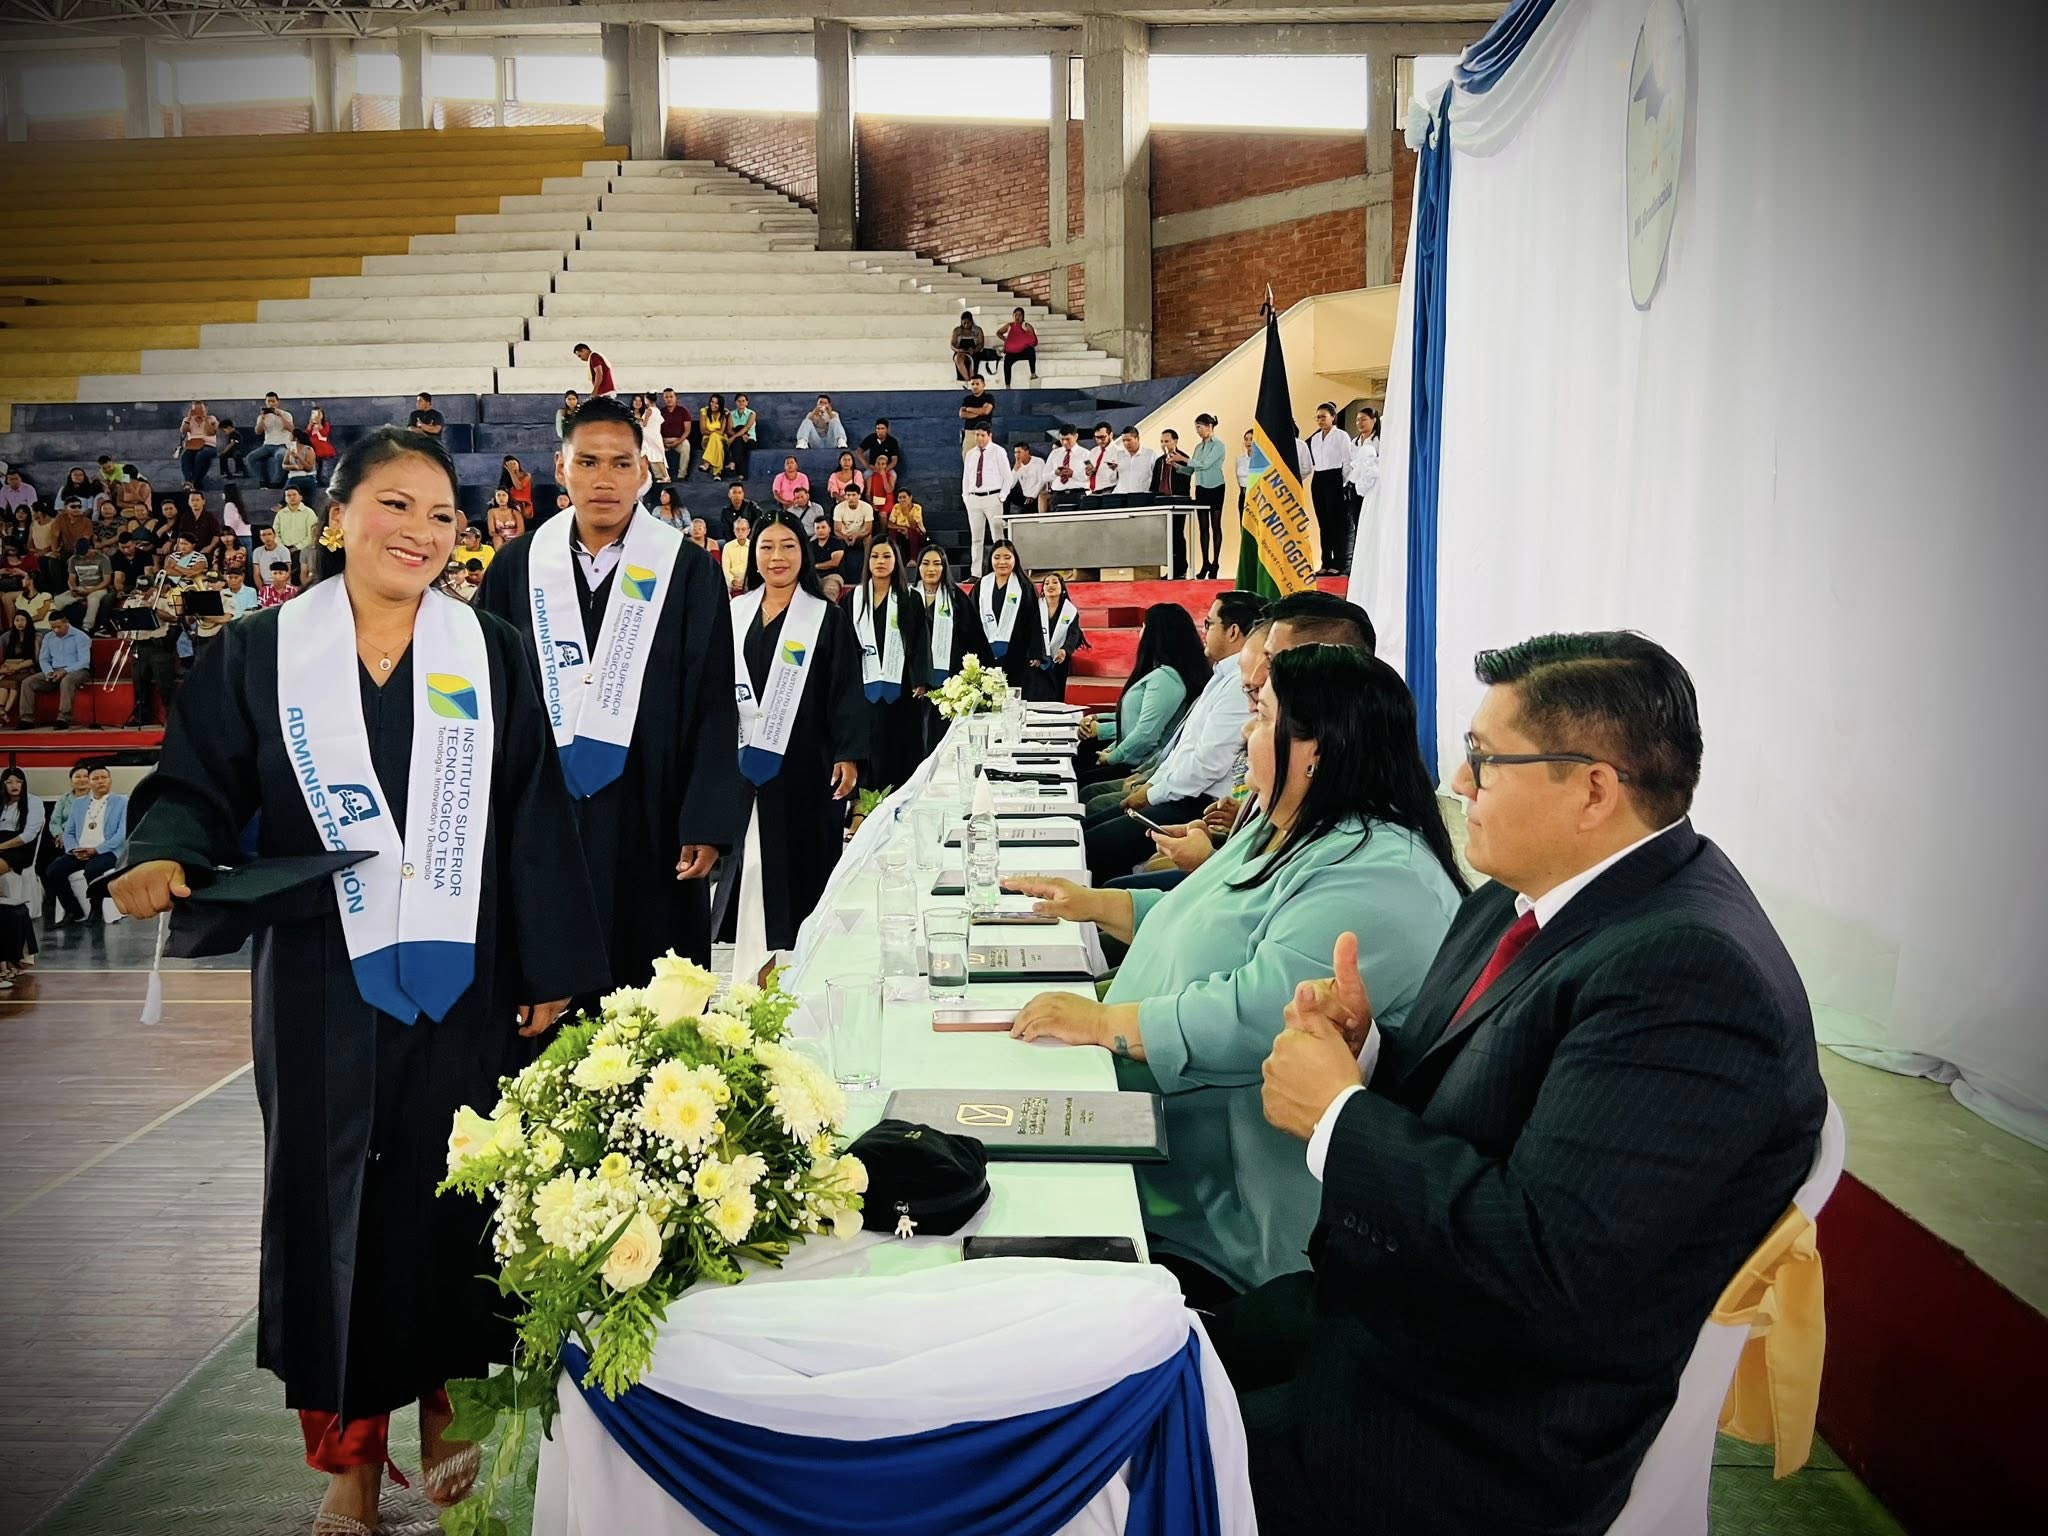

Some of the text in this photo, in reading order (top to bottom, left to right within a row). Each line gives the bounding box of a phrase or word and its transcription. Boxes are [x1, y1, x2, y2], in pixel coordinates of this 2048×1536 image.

[1263, 468, 1310, 539] INSTITU
[534, 588, 563, 727] ADMINISTRACIÓN
[601, 604, 634, 709] TECNOLÓGICO TENA
[611, 606, 645, 716] INSTITUTO SUPERIOR
[287, 707, 365, 914] ADMINISTRAIÓN
[424, 835, 436, 880] Desarrollo
[430, 778, 440, 827] Innovación
[434, 726, 459, 890] TECNOLÓGICO TENA
[450, 727, 474, 897] INSTITUTO SUPERIOR
